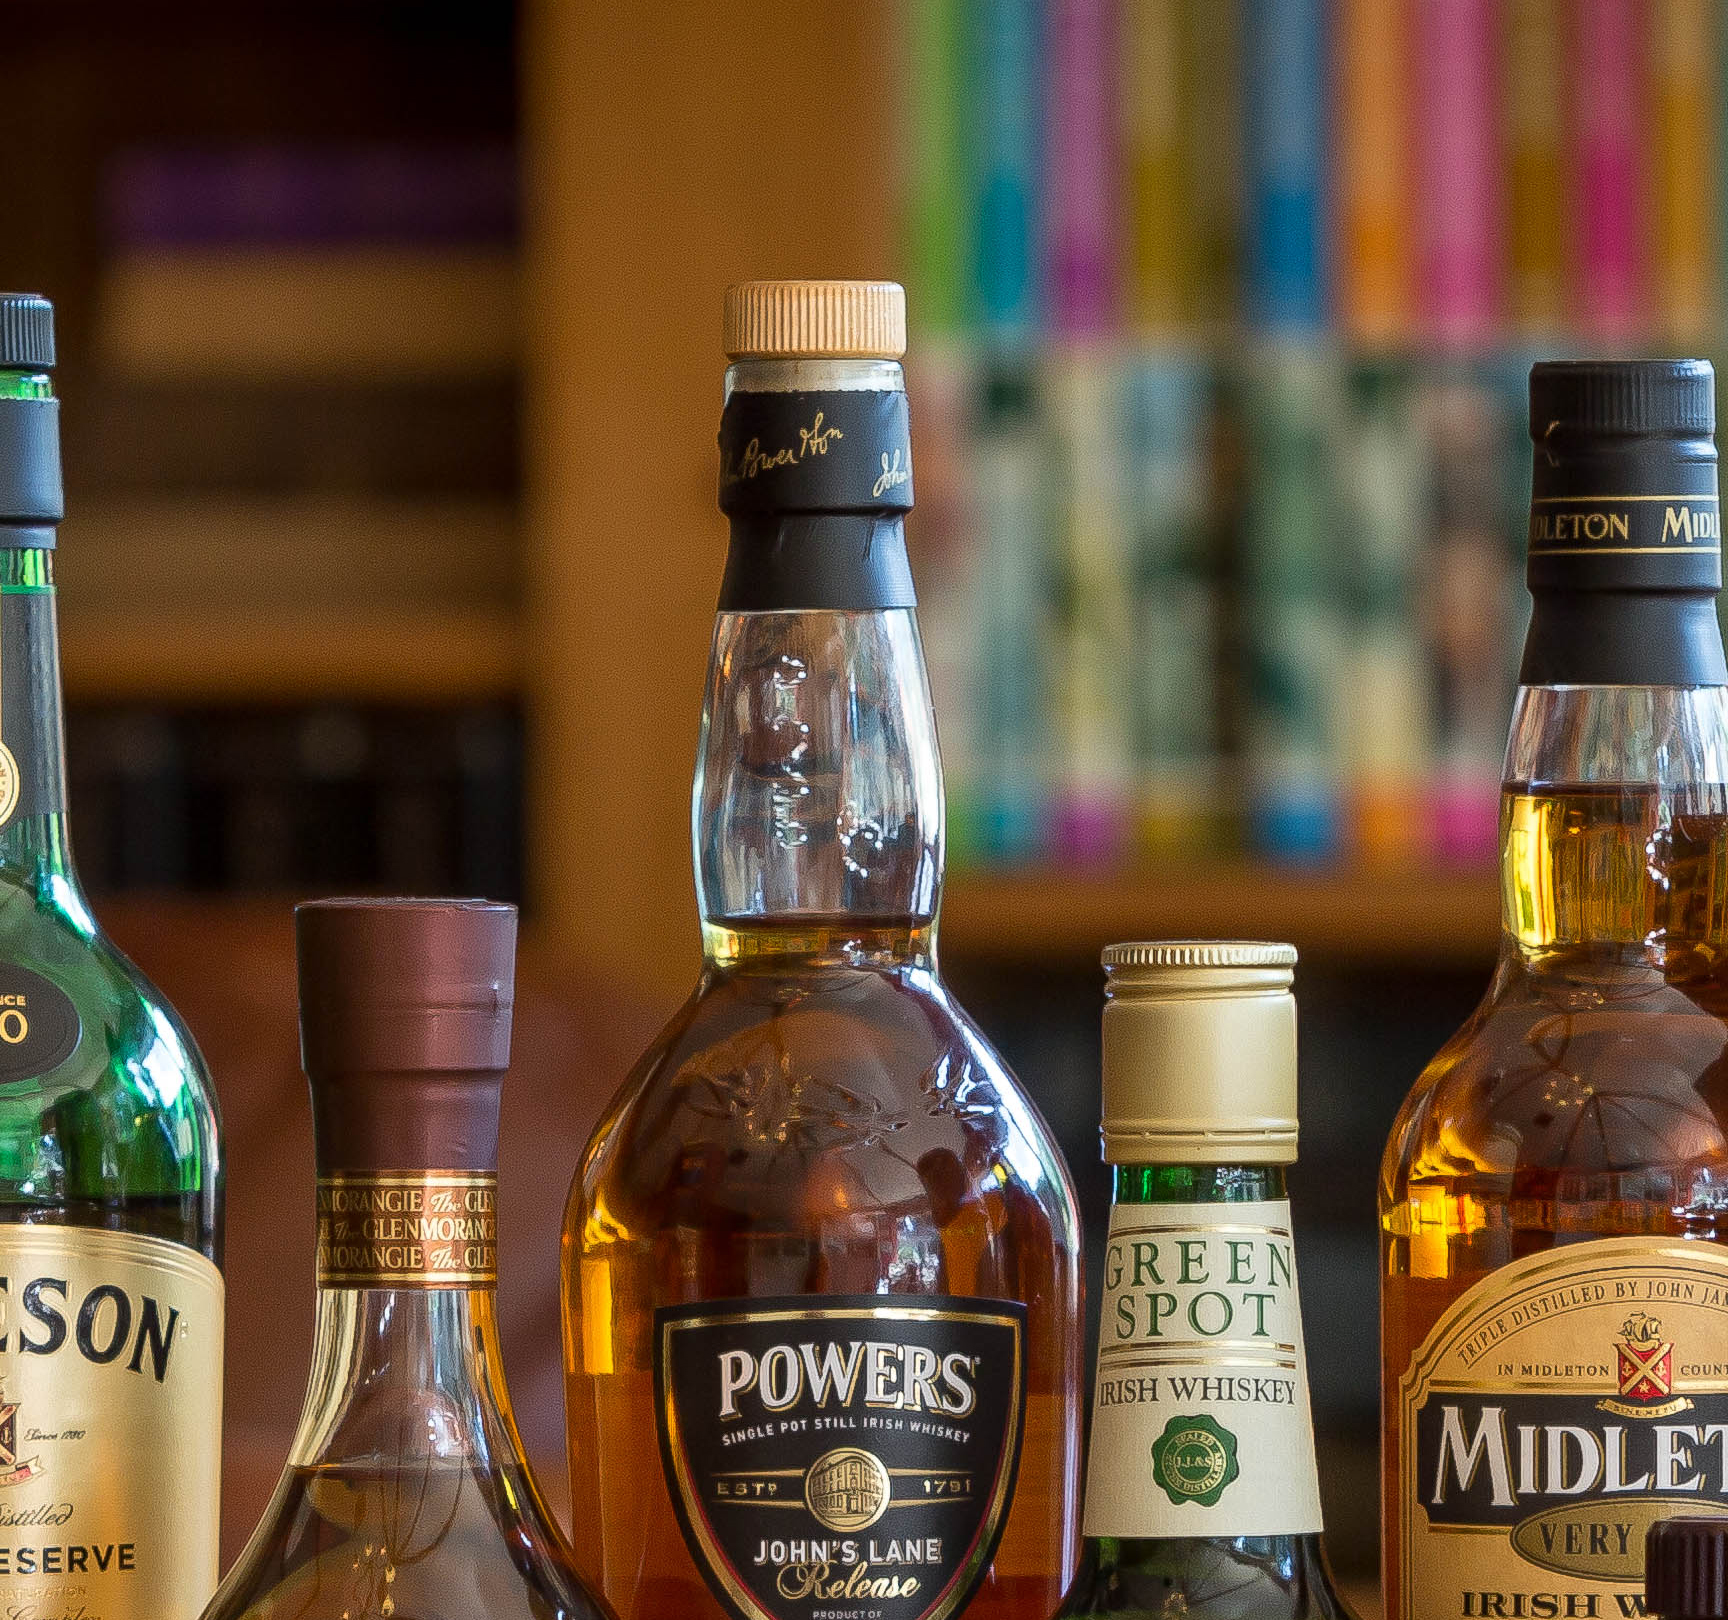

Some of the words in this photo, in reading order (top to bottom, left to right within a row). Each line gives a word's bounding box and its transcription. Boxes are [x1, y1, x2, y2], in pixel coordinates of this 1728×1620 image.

[1105, 1241, 1292, 1291] GREEN
[1116, 1291, 1275, 1339] SPOT
[1457, 1320, 1506, 1366] TRIPLE
[1512, 1285, 1604, 1324] DISTILLED
[1616, 1282, 1637, 1297] BY
[1647, 1282, 1694, 1298] JOHN
[718, 1341, 975, 1419] POWERS
[1100, 1378, 1158, 1406] IRISH
[1167, 1377, 1295, 1405] WHISKEY
[723, 1423, 774, 1445] SINGLE
[781, 1420, 807, 1433] POT
[815, 1417, 856, 1429] STILL
[864, 1418, 903, 1430] IRISH
[910, 1422, 970, 1443] WHISKEY
[754, 1539, 857, 1564] JOHN'S
[870, 1539, 942, 1564] LANE
[1539, 1523, 1633, 1555] VERY
[776, 1561, 921, 1599] Release
[1461, 1591, 1601, 1618] IRISH
